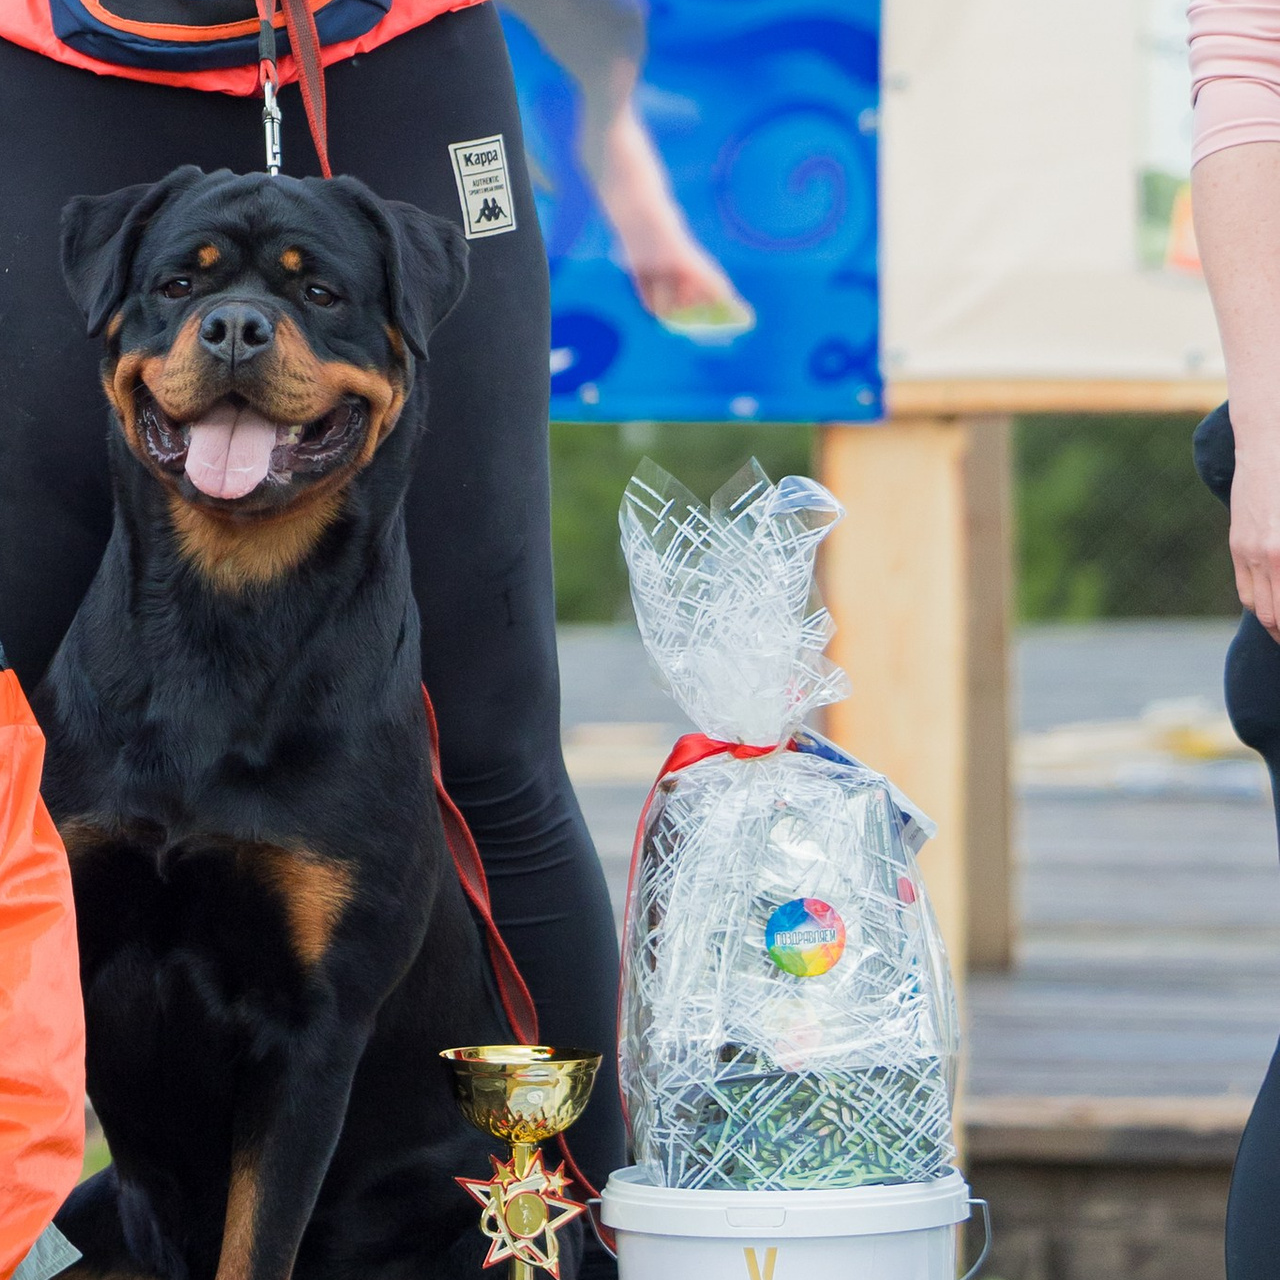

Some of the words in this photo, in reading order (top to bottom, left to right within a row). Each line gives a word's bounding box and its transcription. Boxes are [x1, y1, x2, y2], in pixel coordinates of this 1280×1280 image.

[463, 149, 498, 167] Kappa
[472, 175, 500, 187] AUTHENTIC
[775, 928, 836, 946] ПОЗДРАВЛЯЕМ
